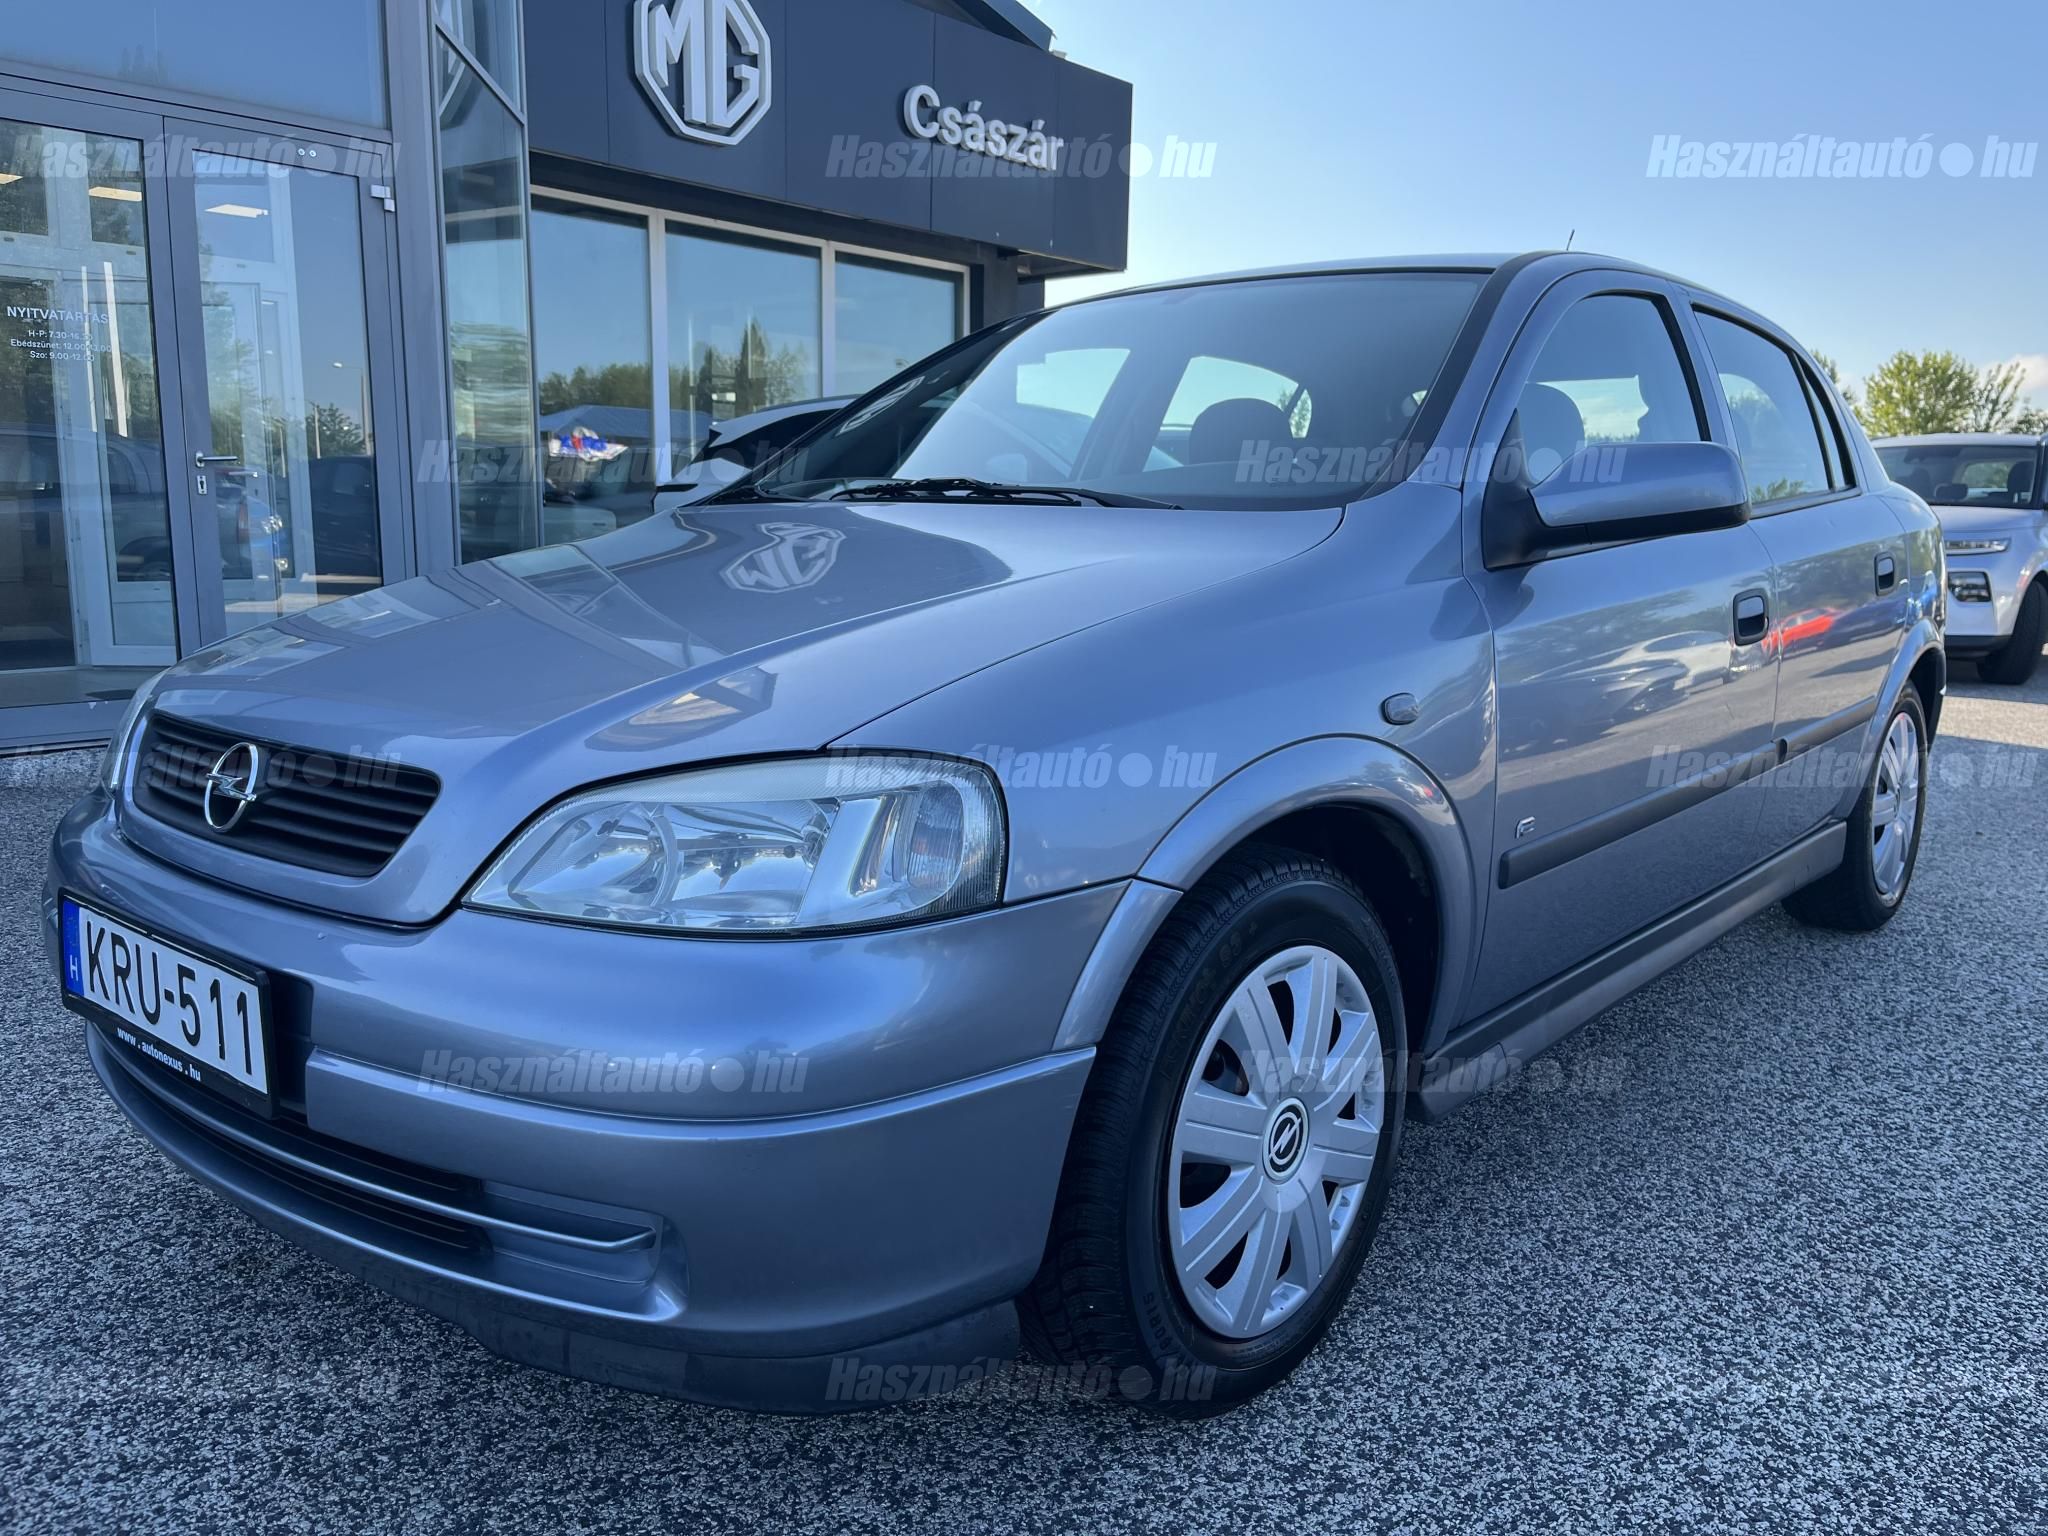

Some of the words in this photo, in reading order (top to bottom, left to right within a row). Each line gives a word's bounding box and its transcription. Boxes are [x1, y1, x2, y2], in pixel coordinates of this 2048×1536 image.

[648, 0, 760, 128] MG
[903, 84, 1064, 171] Császár
[86, 919, 253, 1077] KRU-511
